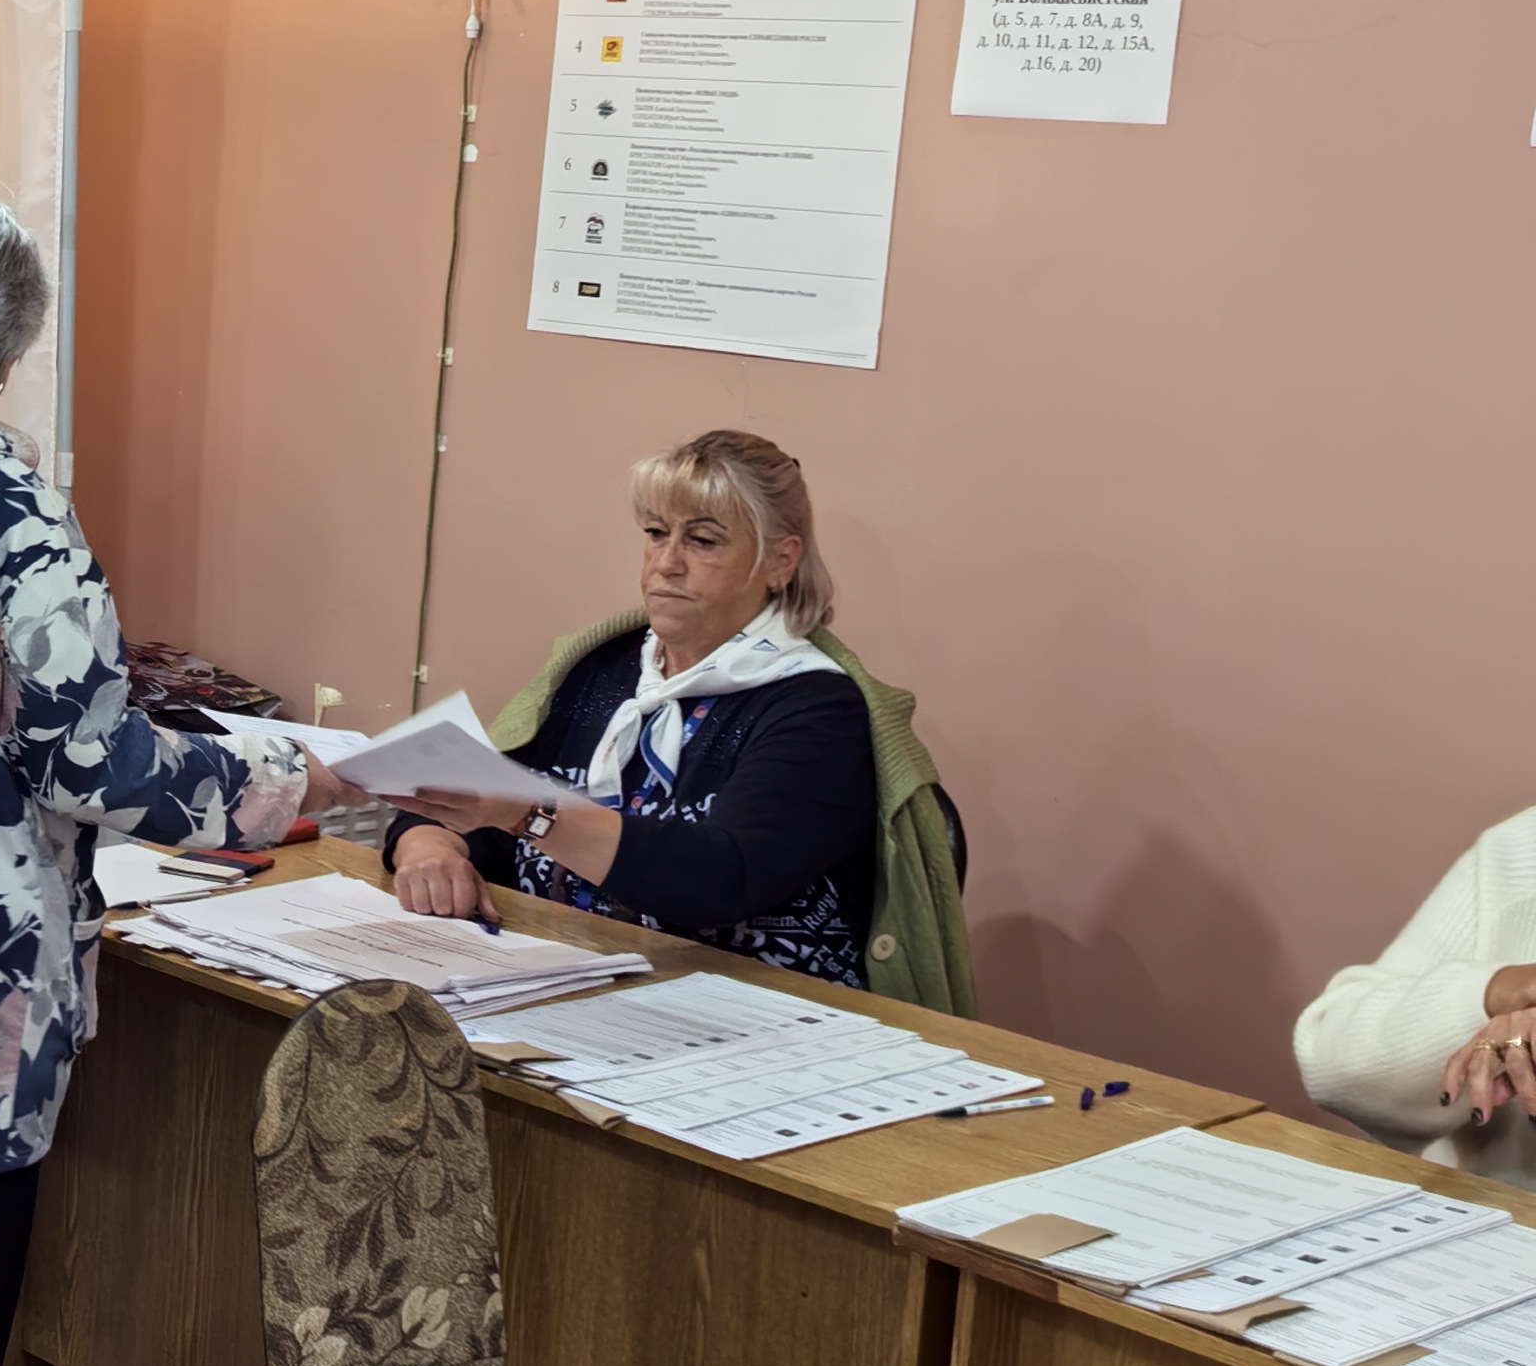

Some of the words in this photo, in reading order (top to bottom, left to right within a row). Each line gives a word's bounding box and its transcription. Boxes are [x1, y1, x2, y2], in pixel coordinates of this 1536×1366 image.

[992, 11, 1010, 29] (д.
[1015, 11, 1028, 28] 5,
[1030, 15, 1044, 28] д.
[1049, 12, 1061, 28] 7,
[1064, 15, 1077, 29] д.
[1111, 16, 1125, 30] д.
[1129, 13, 1143, 31] 9,
[575, 40, 582, 53] 4
[976, 35, 989, 48] д.
[994, 33, 1014, 49] 10,
[1017, 36, 1030, 49] д.
[1035, 34, 1055, 50] 11,
[1058, 37, 1072, 50] д.
[1078, 35, 1098, 51] 12,
[1102, 38, 1115, 51] д.
[1059, 58, 1073, 72] д.
[1078, 57, 1102, 74] 20)
[569, 98, 577, 112] 5
[564, 157, 572, 171] 6
[558, 216, 567, 229] 7
[552, 280, 560, 294] 8
